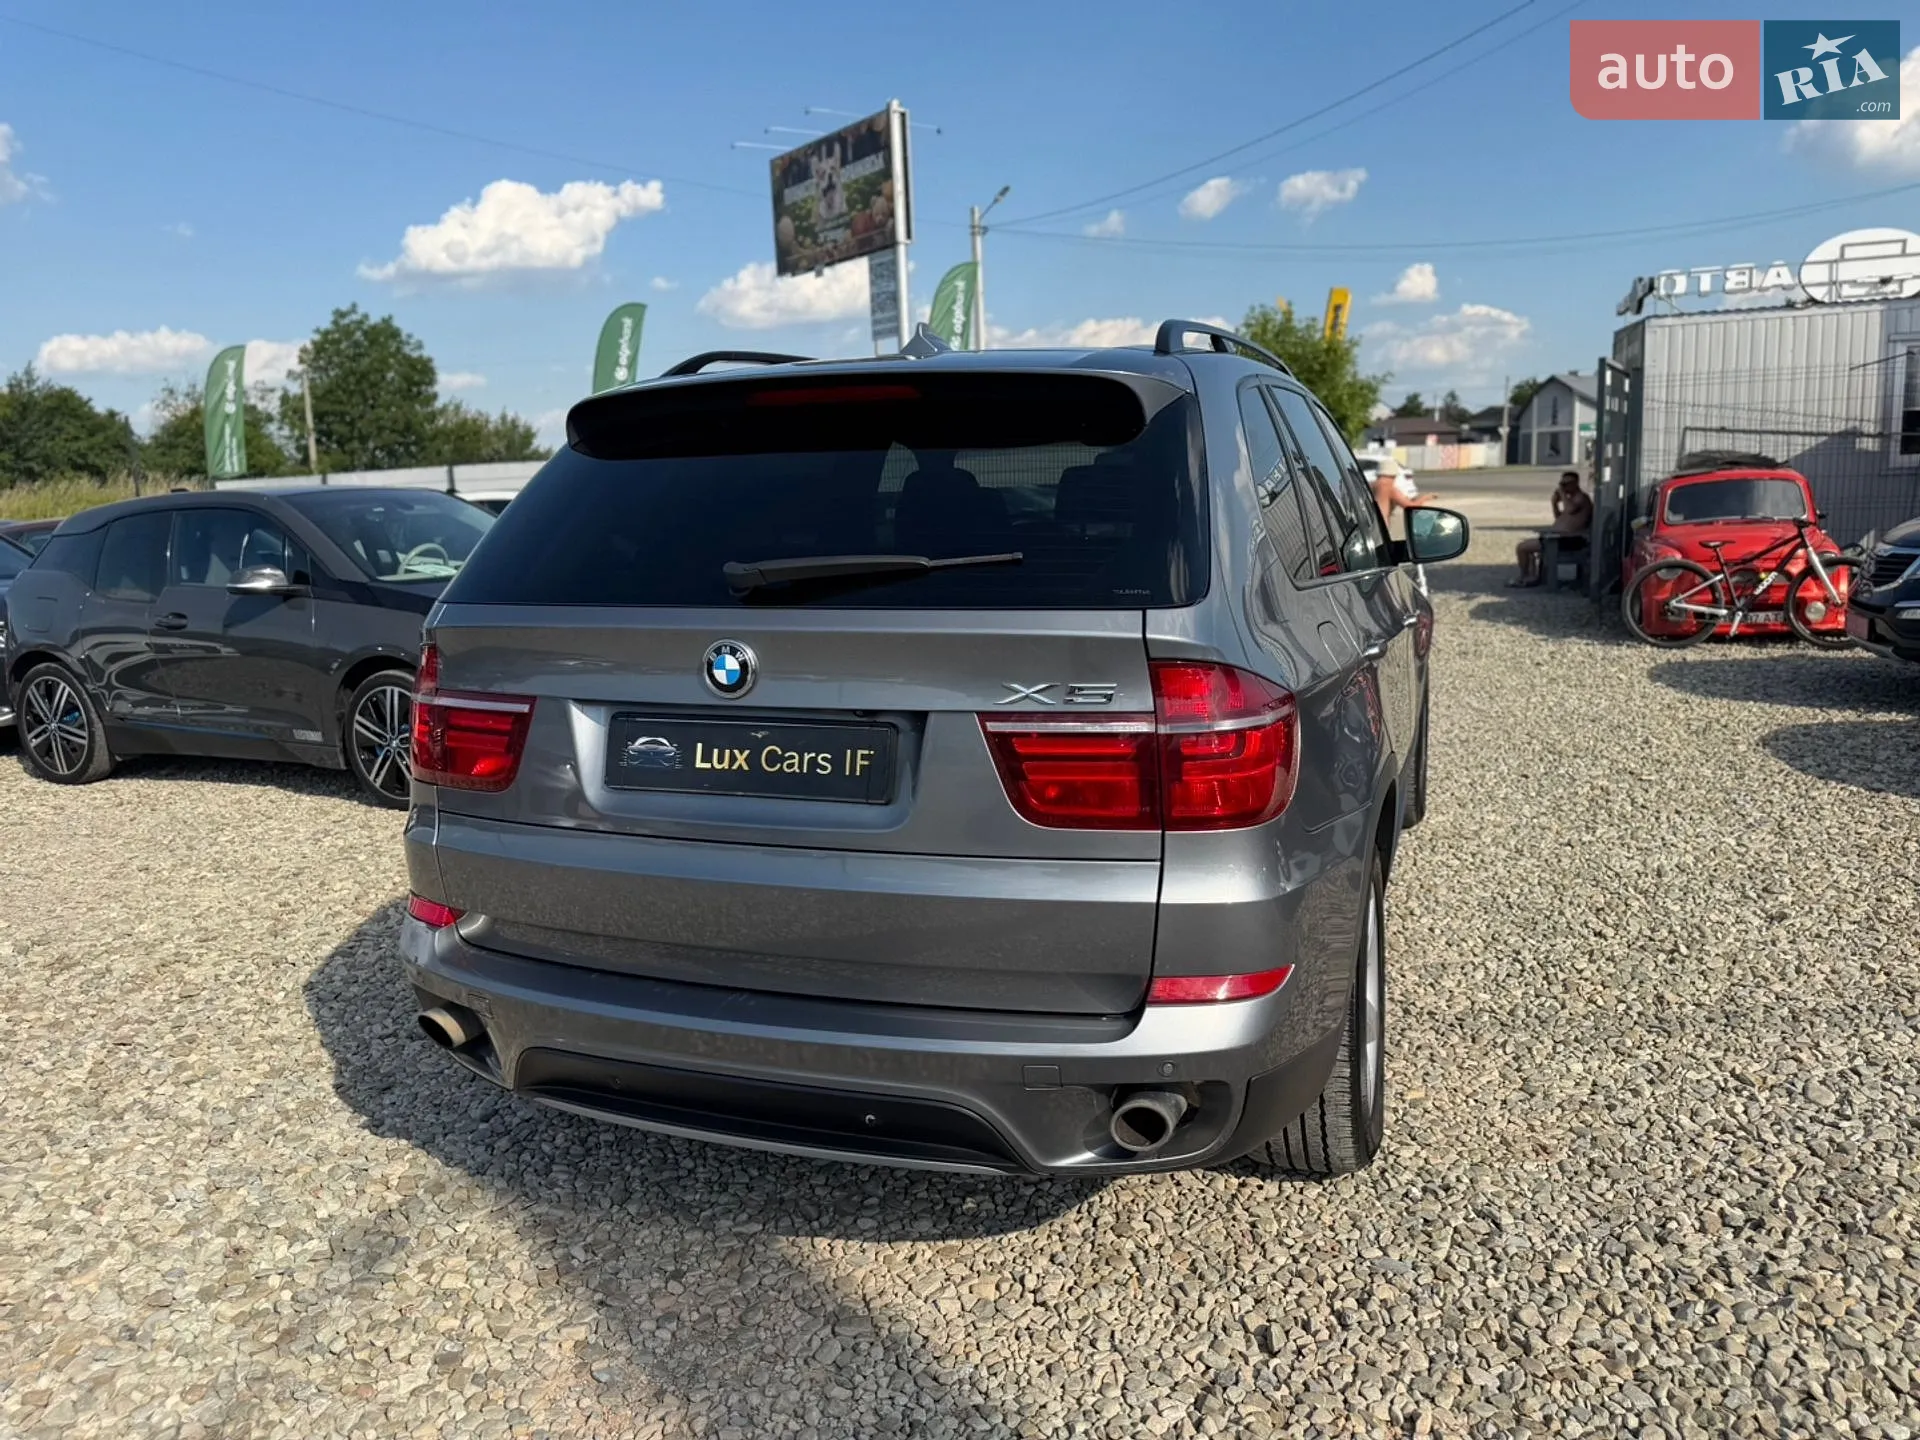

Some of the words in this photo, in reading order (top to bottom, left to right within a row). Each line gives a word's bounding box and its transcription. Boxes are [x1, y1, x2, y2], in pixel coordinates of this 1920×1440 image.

[993, 682, 1118, 705] X5
[694, 742, 751, 771] Lux
[760, 745, 832, 775] Cars
[845, 749, 873, 776] IF
